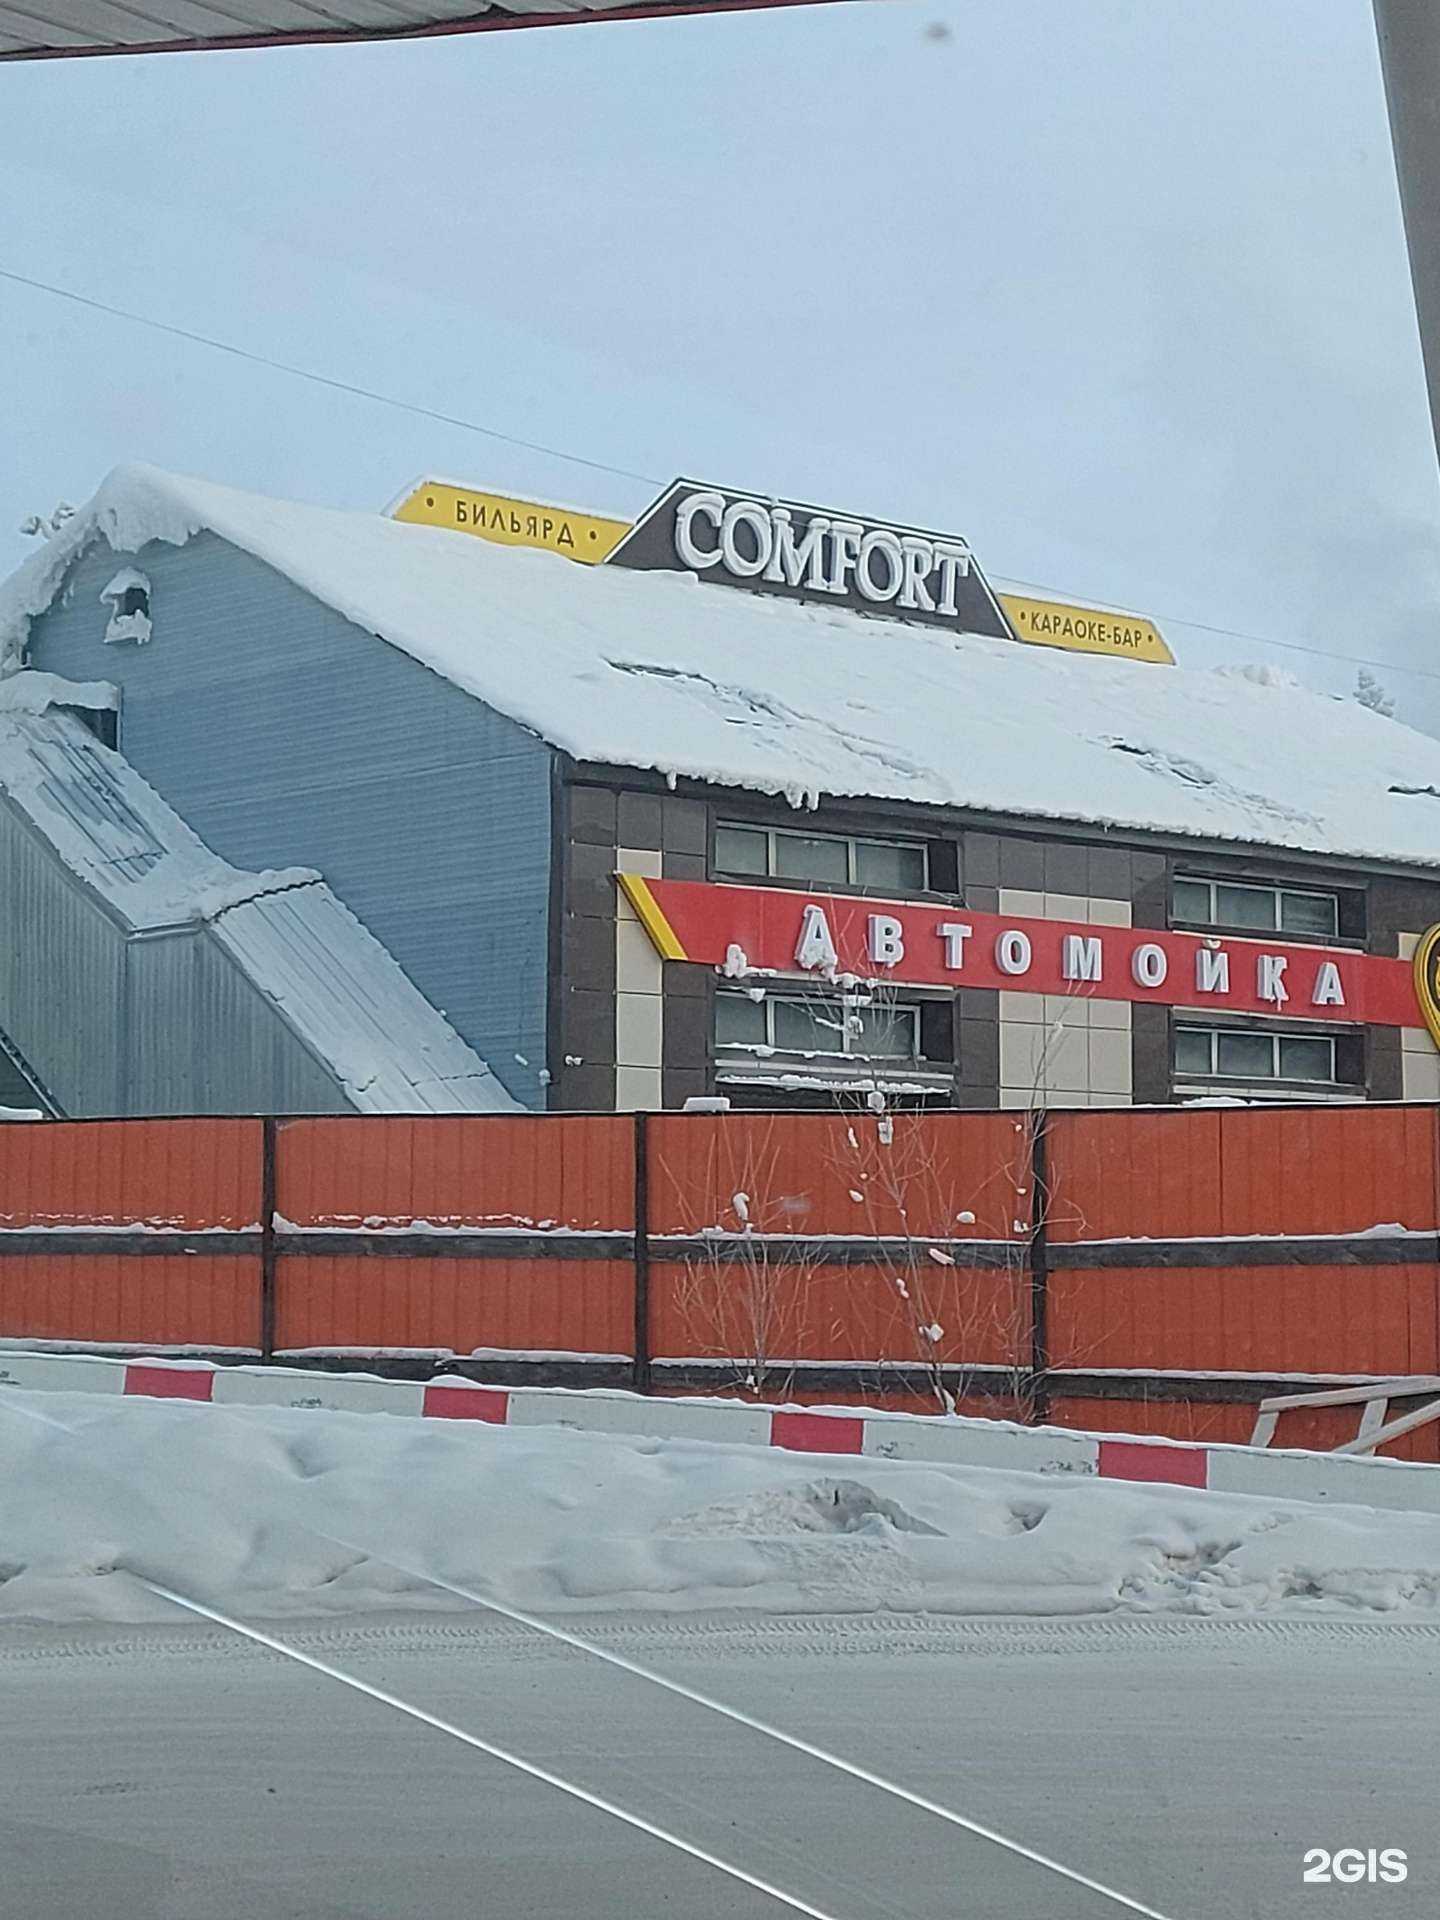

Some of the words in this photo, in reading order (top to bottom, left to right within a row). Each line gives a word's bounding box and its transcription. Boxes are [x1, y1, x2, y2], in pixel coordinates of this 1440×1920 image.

[455, 500, 574, 547] БИЛЬЯРД
[675, 492, 970, 616] COMFORT
[1030, 611, 1142, 648] КАРАОКЕ-БАР
[795, 904, 1346, 1005] АВТОМОЙКА
